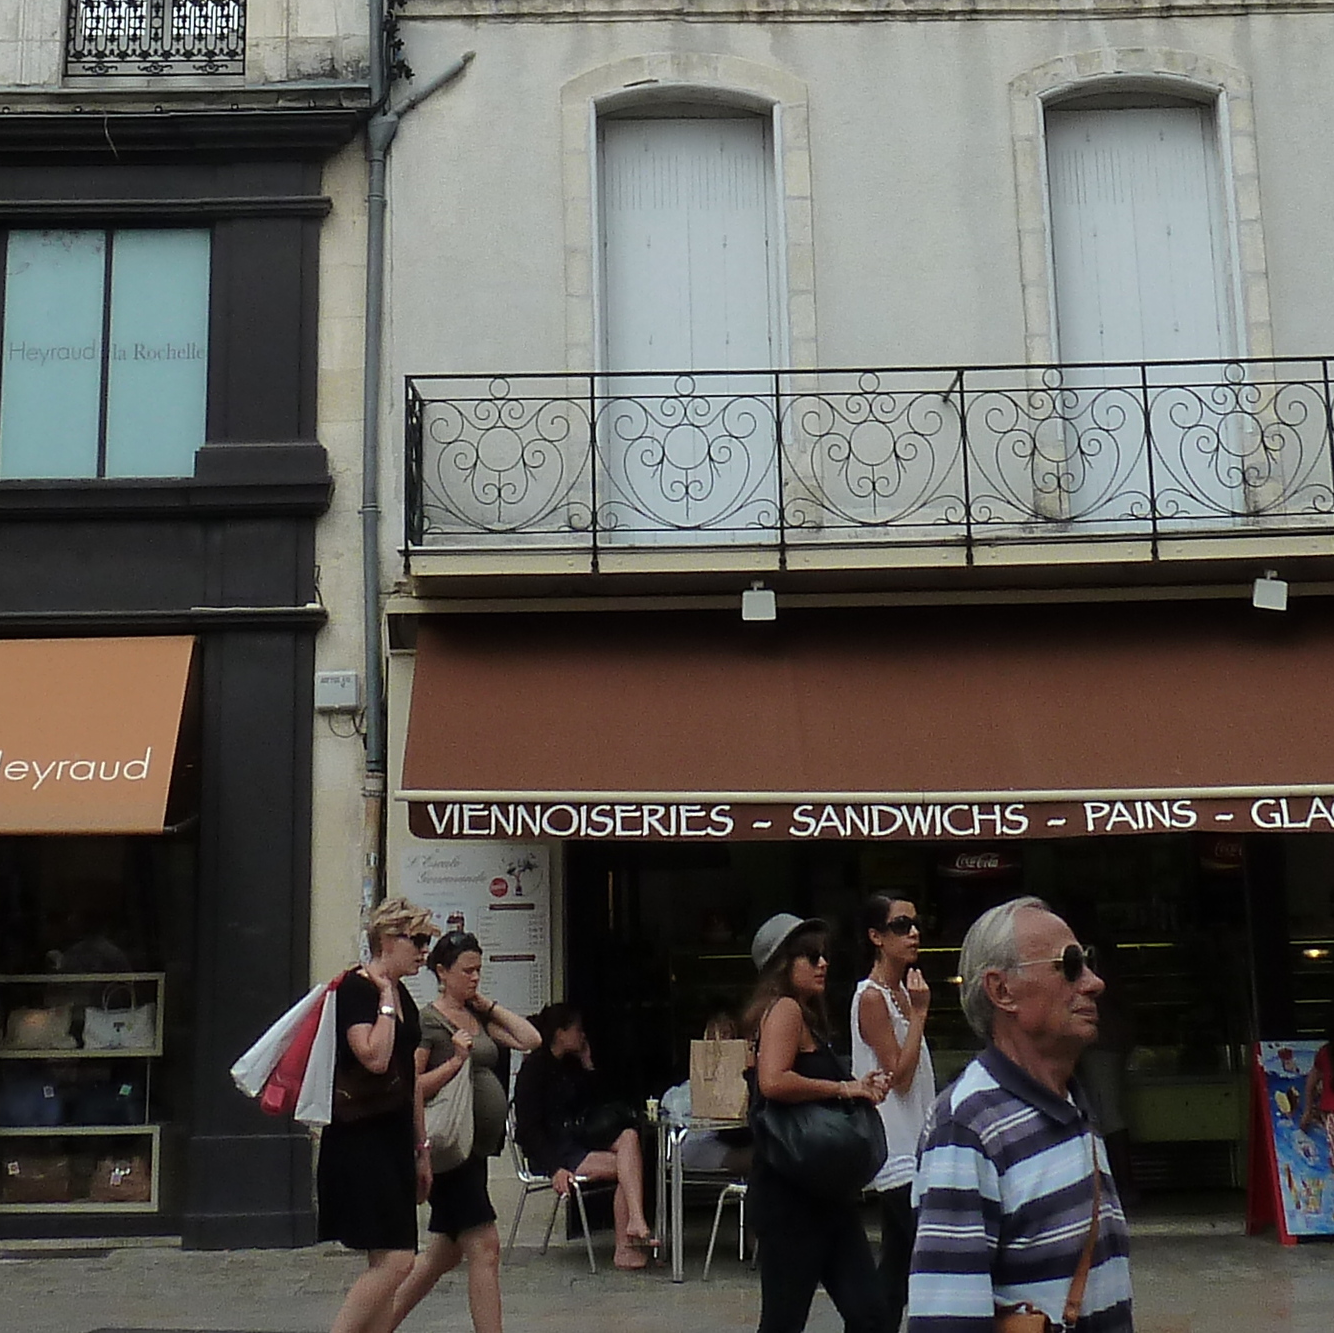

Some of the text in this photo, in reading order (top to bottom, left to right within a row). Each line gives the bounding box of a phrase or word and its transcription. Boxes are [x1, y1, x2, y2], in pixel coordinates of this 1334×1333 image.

[8, 339, 204, 366] Heyraud la Rochelle
[427, 803, 734, 838] VIENNOISERIES
[789, 802, 1029, 837] SANDWICHS
[1084, 799, 1197, 832] PAINS
